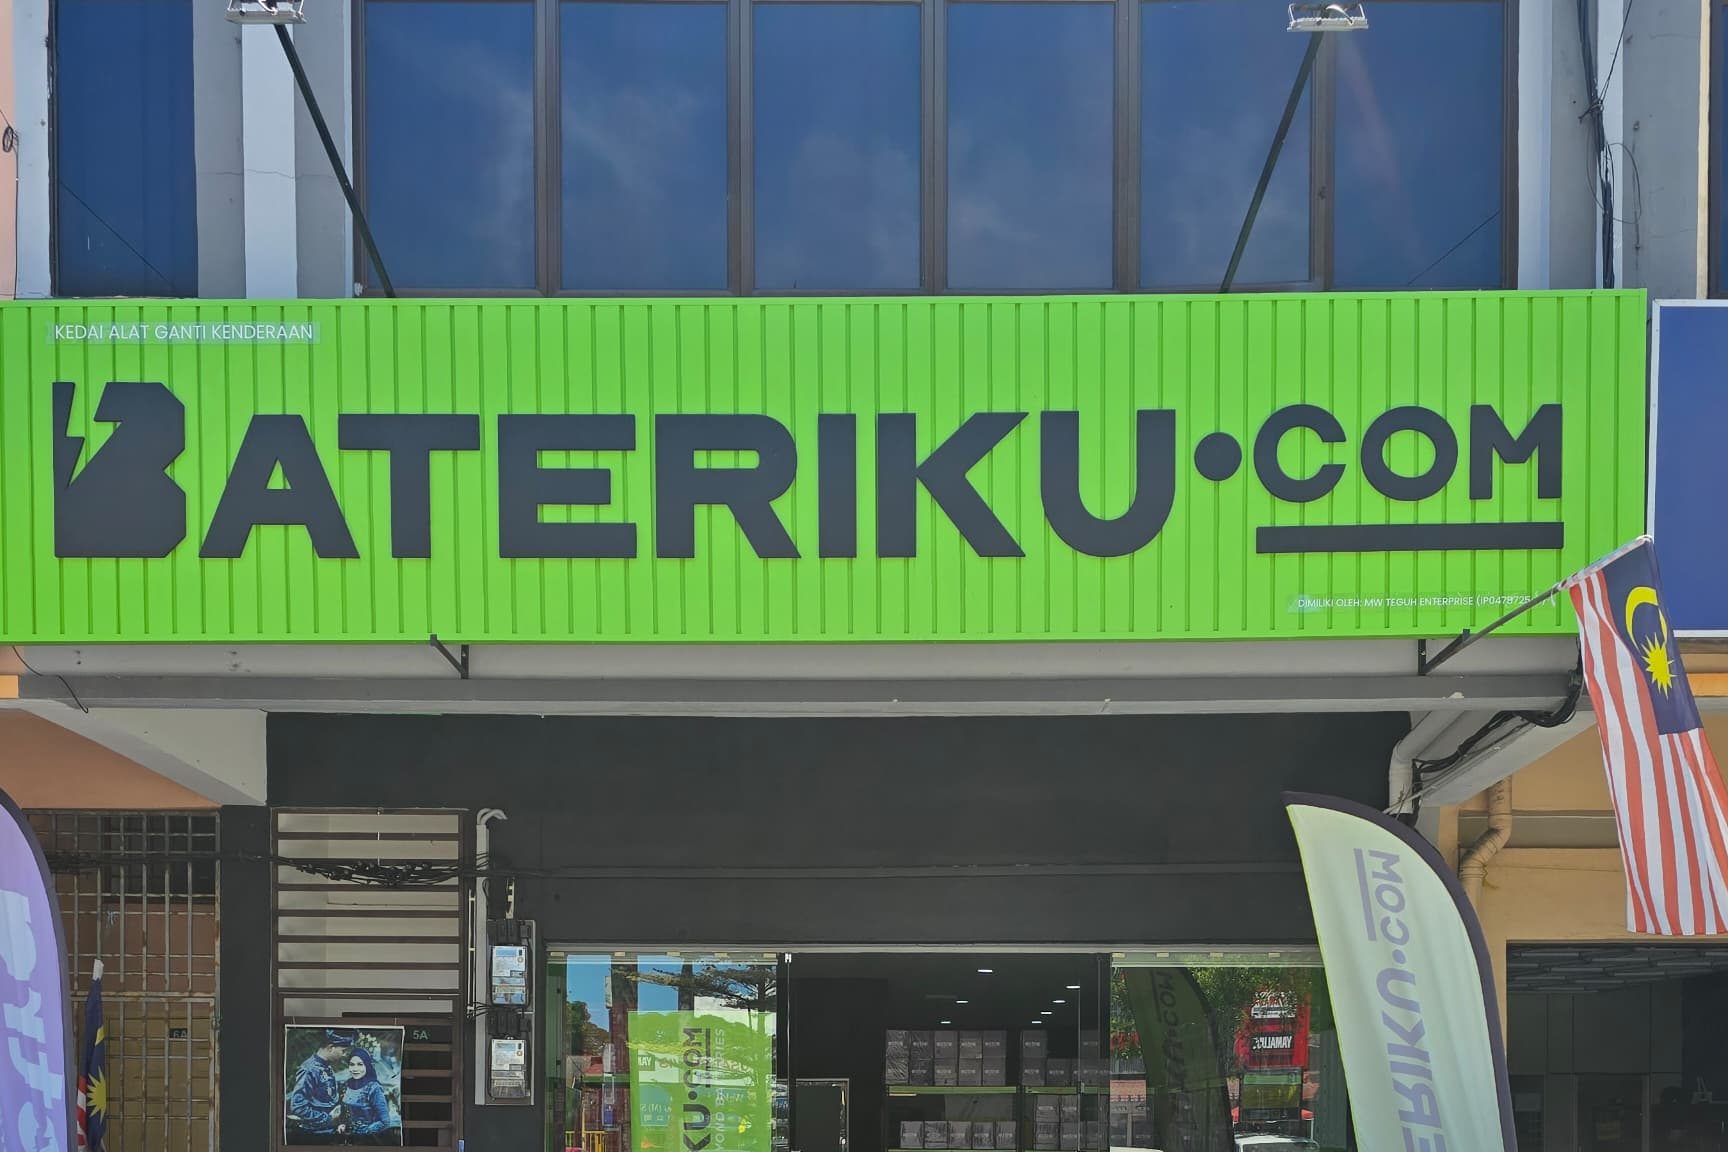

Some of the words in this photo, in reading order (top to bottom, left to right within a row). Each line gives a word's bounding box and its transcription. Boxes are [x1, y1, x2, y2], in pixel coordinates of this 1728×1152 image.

[54, 324, 103, 340] KEDAI
[108, 324, 150, 340] ALAT
[154, 324, 206, 340] GANTI
[211, 324, 313, 340] KENDERAAN
[1297, 597, 1334, 609] DIMILIKI
[1336, 597, 1362, 609] OLEH:
[1364, 597, 1383, 608] MW
[1385, 596, 1417, 608] TEGUH
[1419, 595, 1474, 607] ENTERPRISE
[412, 1029, 429, 1041] 5A
